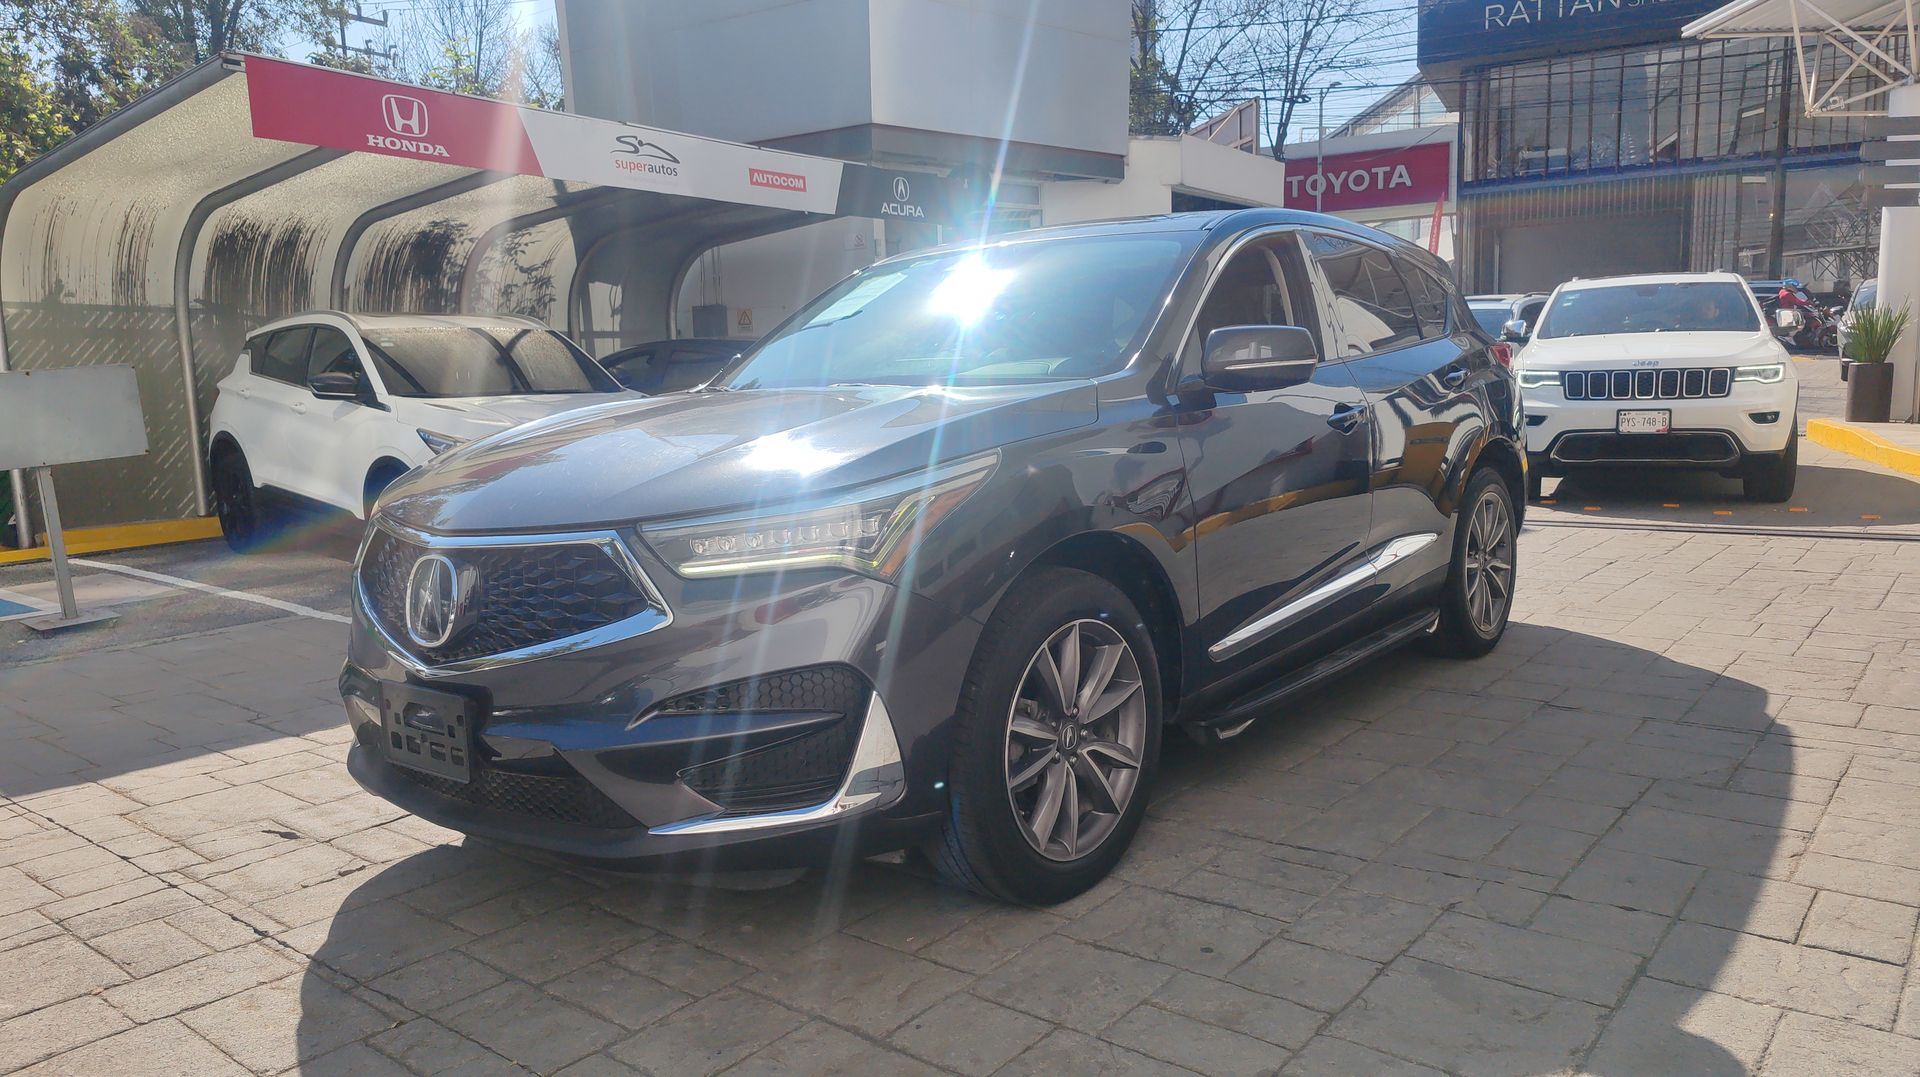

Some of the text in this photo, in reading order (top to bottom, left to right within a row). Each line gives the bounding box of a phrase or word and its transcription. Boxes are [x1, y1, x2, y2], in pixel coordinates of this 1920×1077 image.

[366, 134, 450, 157] HONDA
[615, 159, 679, 177] superautos
[752, 172, 804, 189] AUTOCOM
[1286, 165, 1412, 198] TOYOTA
[880, 202, 925, 218] ACURA
[1620, 416, 1667, 427] PYS-748-B
